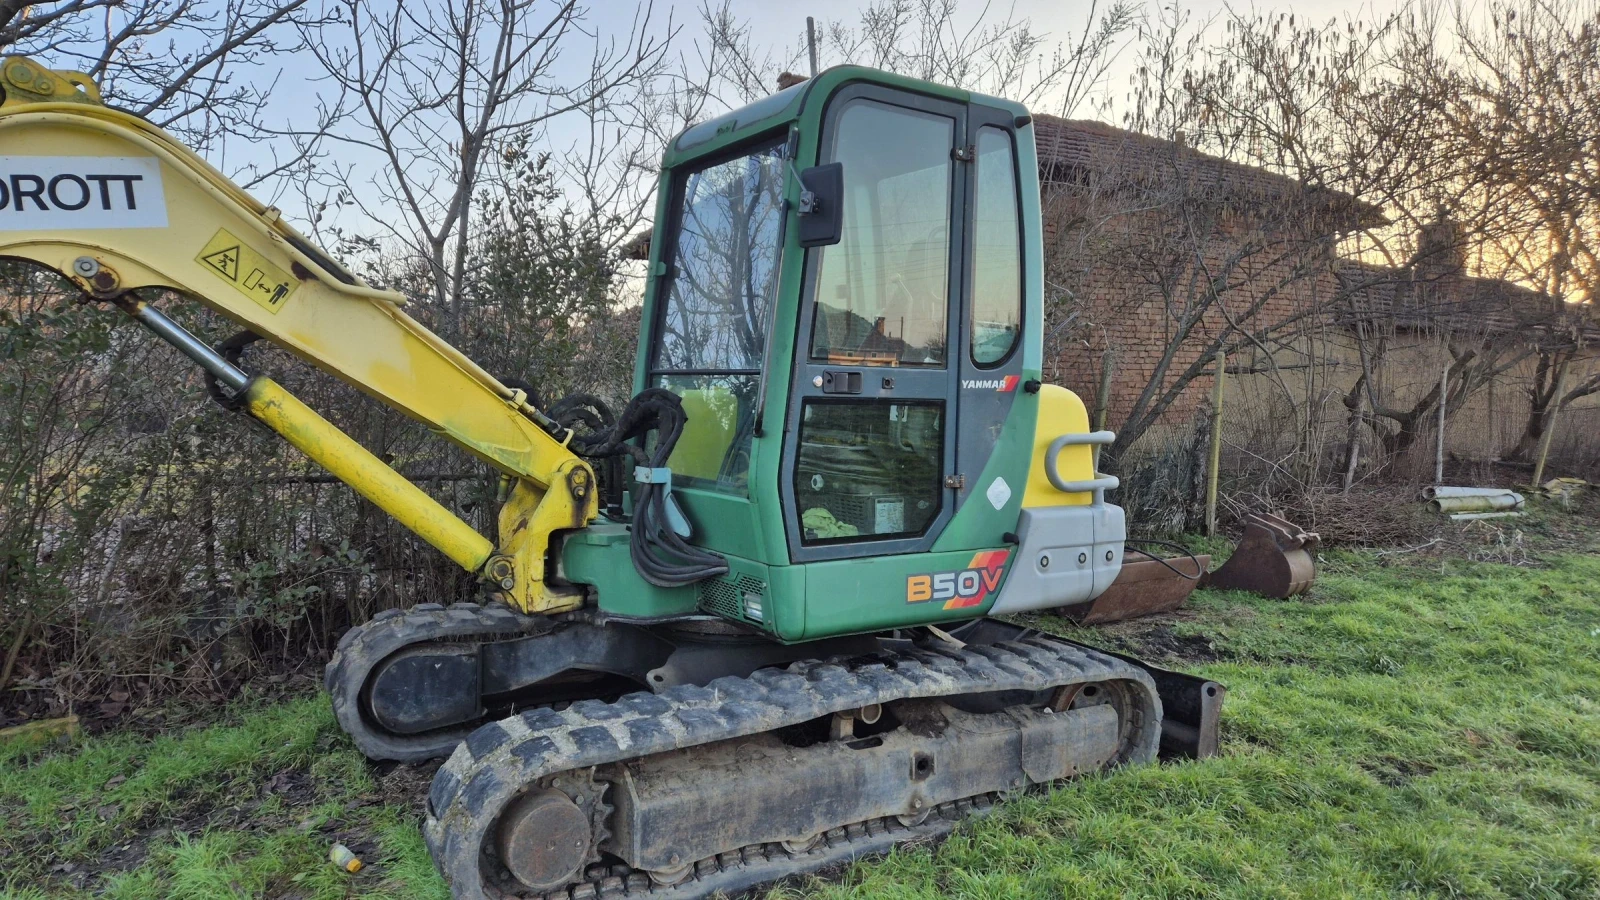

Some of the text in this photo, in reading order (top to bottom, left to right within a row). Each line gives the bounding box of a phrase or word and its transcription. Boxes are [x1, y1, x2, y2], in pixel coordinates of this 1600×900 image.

[0, 174, 143, 212] ROTT
[961, 379, 1006, 389] YANMAR
[907, 568, 1003, 602] B50V
